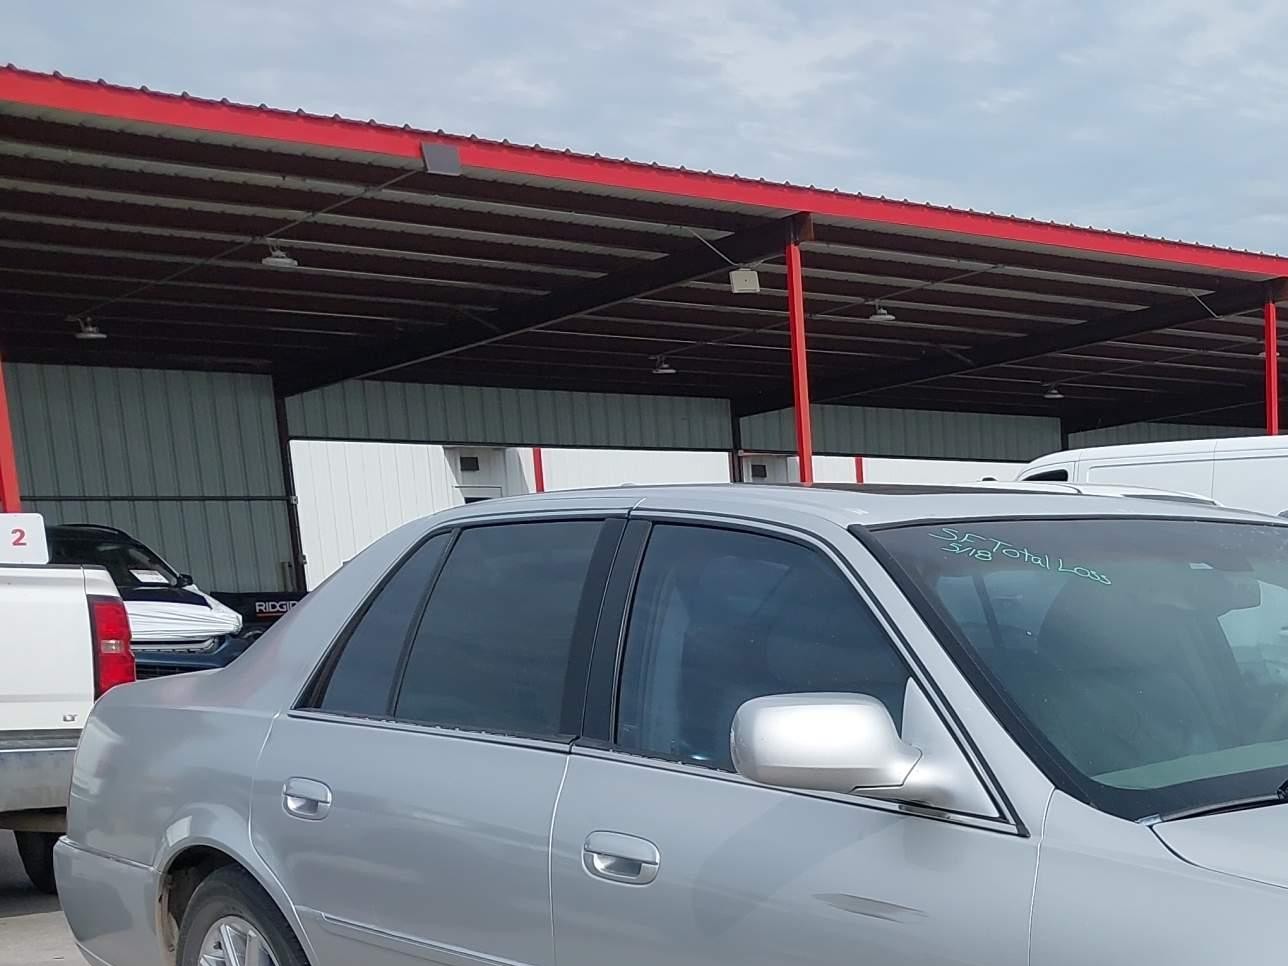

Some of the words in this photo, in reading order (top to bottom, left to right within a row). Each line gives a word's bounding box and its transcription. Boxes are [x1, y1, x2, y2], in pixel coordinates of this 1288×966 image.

[11, 528, 27, 546] 2
[990, 537, 1051, 570] Total
[1058, 558, 1112, 585] Loss
